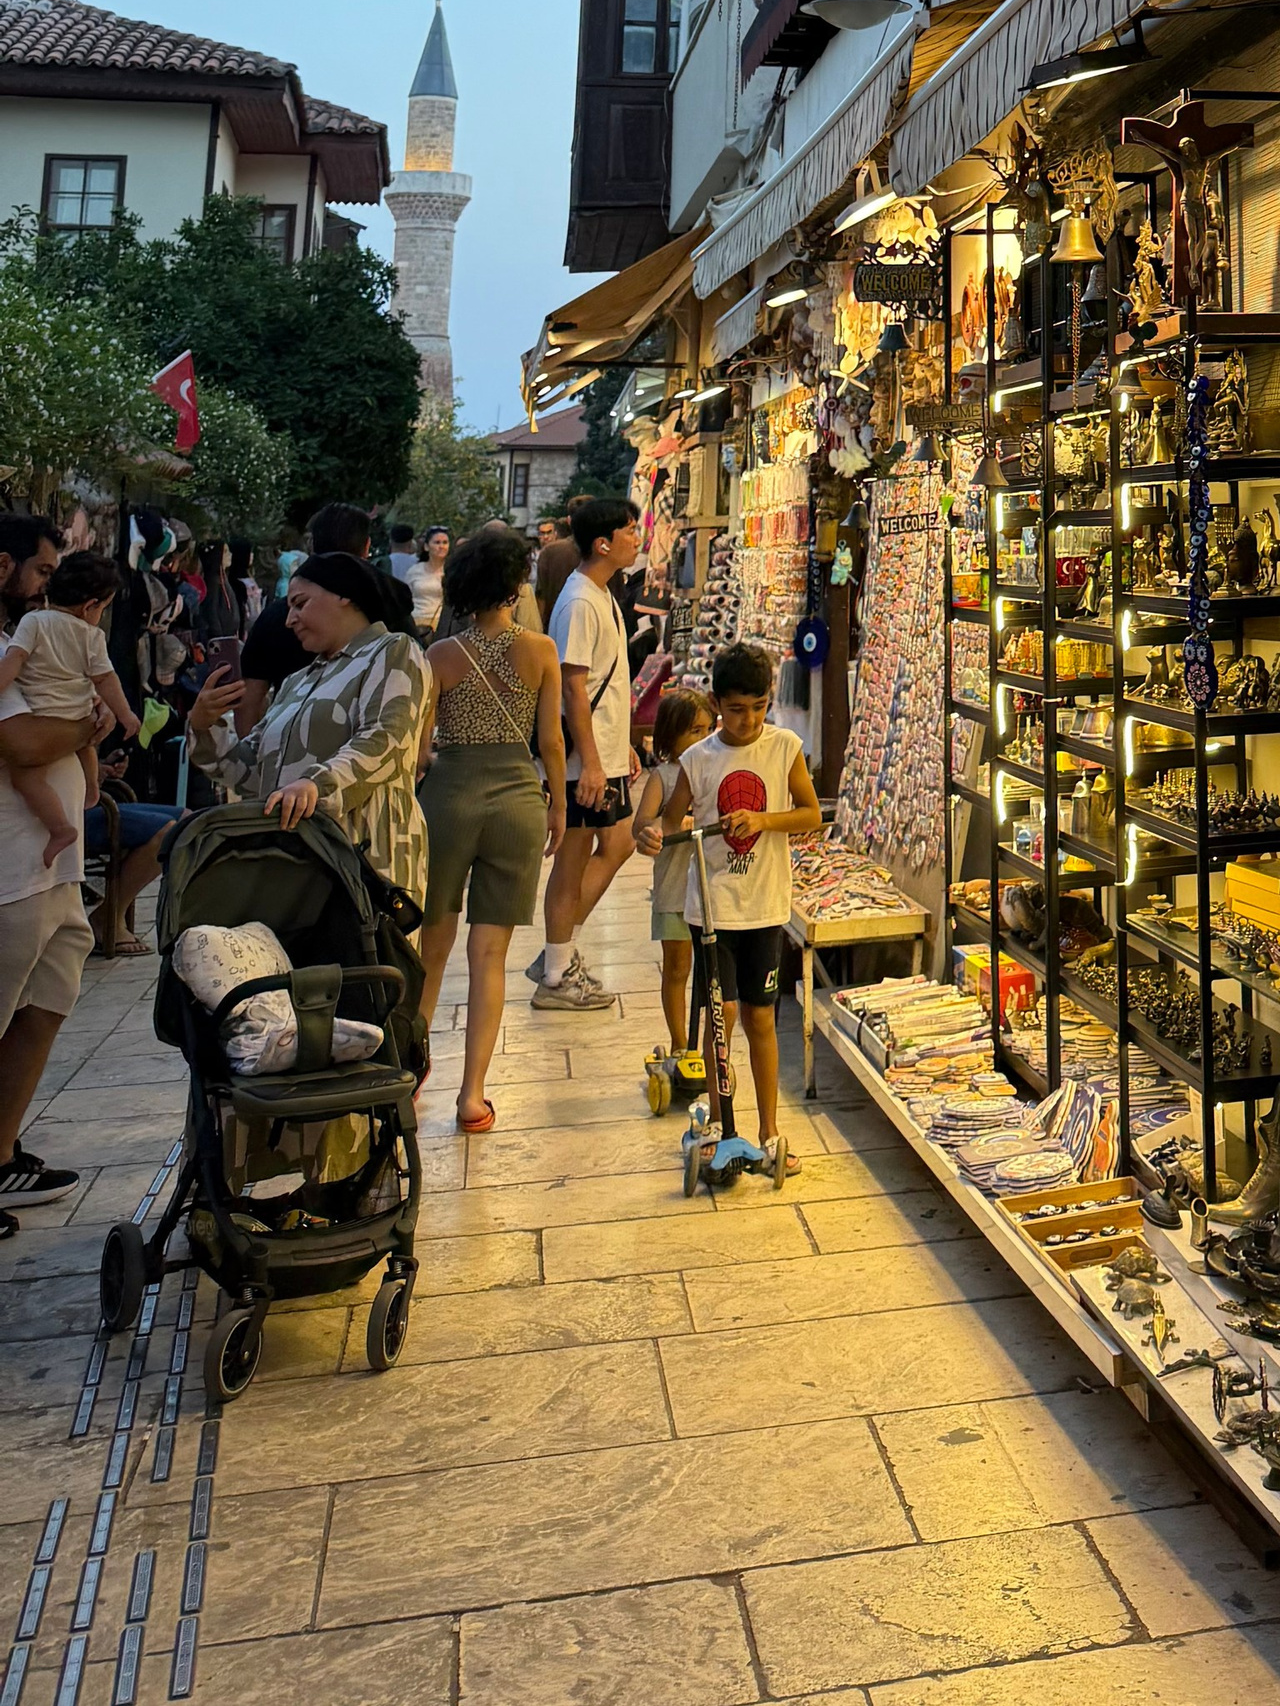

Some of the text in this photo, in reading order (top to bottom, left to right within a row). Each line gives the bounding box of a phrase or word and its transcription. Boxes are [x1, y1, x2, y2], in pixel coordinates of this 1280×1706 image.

[861, 273, 931, 291] WELCOME
[908, 404, 982, 421] WELCOME
[880, 513, 937, 534] WELCOME
[728, 861, 748, 875] MAN
